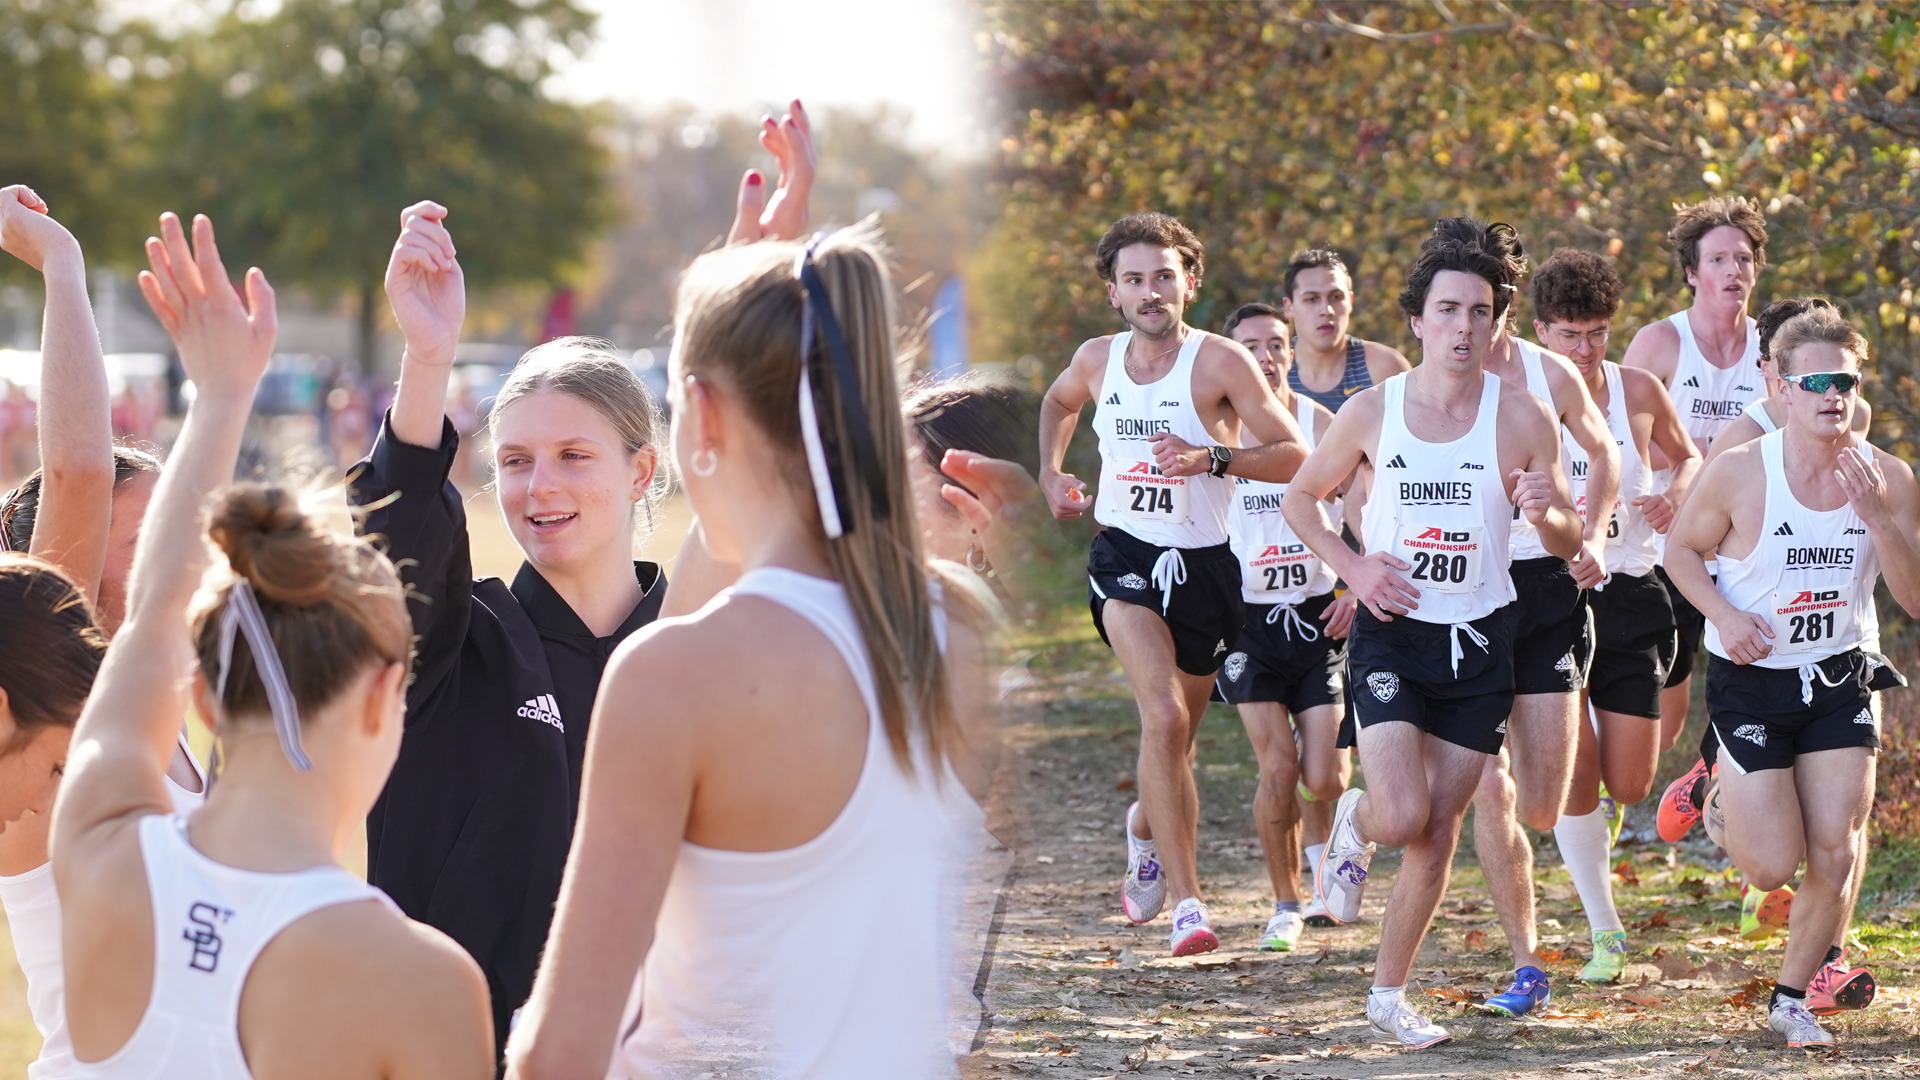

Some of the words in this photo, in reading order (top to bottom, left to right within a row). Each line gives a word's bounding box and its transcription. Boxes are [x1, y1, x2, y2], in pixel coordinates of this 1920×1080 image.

[1158, 400, 1180, 408] A10
[1459, 462, 1485, 470] A10
[1116, 473, 1185, 486] CHAMPIONSHIPS
[1399, 481, 1472, 500] BONNIES
[1129, 485, 1174, 514] 274
[1416, 526, 1470, 543] A10
[1259, 543, 1305, 558] A10
[1403, 538, 1478, 552] CHAMPIONSHIPS
[1249, 552, 1315, 567] CHAMPIONSHIPS
[1785, 546, 1855, 565] BONNIES
[1411, 551, 1468, 584] 280
[1263, 563, 1308, 591] 279
[1789, 590, 1839, 605] A10
[1776, 600, 1848, 615] CHAMPIONSHIPS
[1789, 611, 1835, 644] 281
